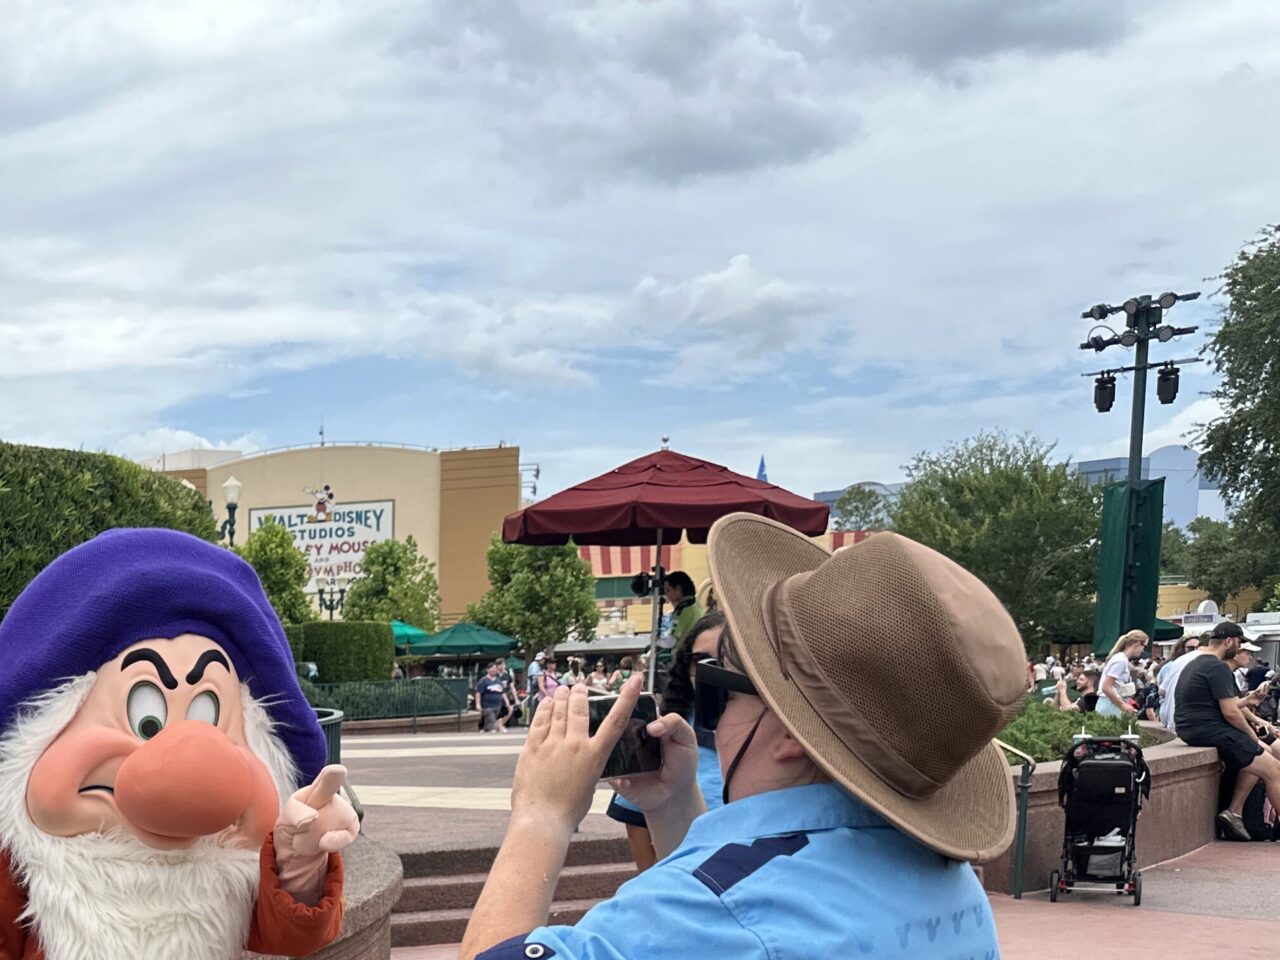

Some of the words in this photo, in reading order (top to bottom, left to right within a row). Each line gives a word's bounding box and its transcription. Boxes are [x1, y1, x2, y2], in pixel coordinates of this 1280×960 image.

[258, 514, 307, 530] WALT
[333, 509, 384, 532] DISNEY
[292, 527, 355, 541] STUDIOS
